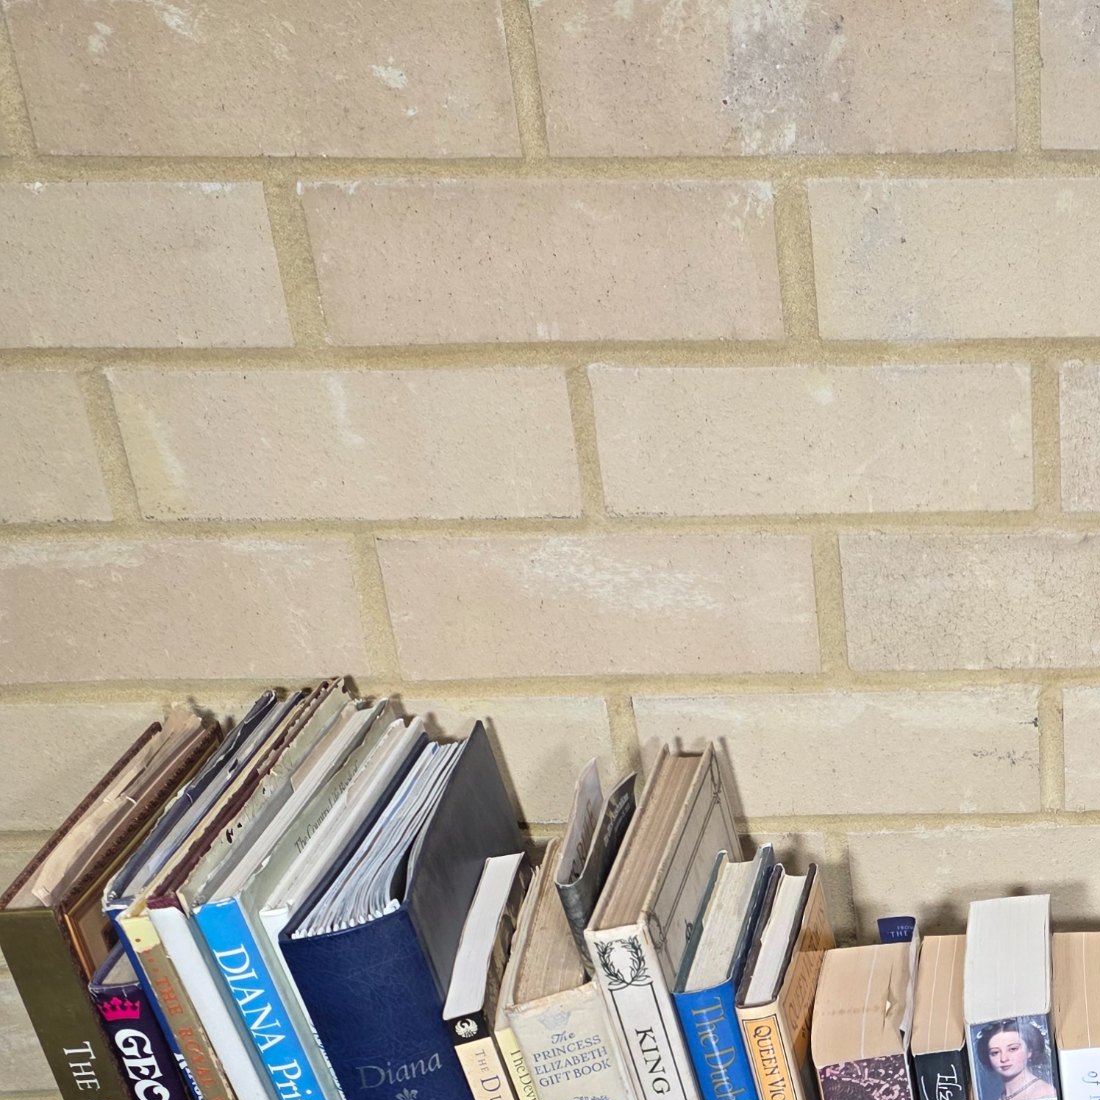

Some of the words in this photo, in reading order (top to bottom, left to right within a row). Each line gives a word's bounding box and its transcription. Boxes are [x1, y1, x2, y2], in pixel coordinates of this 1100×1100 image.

[213, 943, 282, 1054] DIANA
[159, 977, 184, 1016] THE
[178, 1026, 213, 1088] ROYAL
[551, 1030, 576, 1044] The
[691, 996, 725, 1048] The
[63, 1041, 101, 1092] THE
[474, 1048, 490, 1073] THE
[532, 1034, 602, 1063] PRINCESS
[534, 1046, 608, 1076] ELIZABETH
[635, 1027, 671, 1095] KING
[752, 1025, 779, 1077] QUEEN
[355, 1052, 443, 1090] Diana
[538, 1070, 573, 1088] GIFT
[574, 1058, 612, 1079] BOOK
